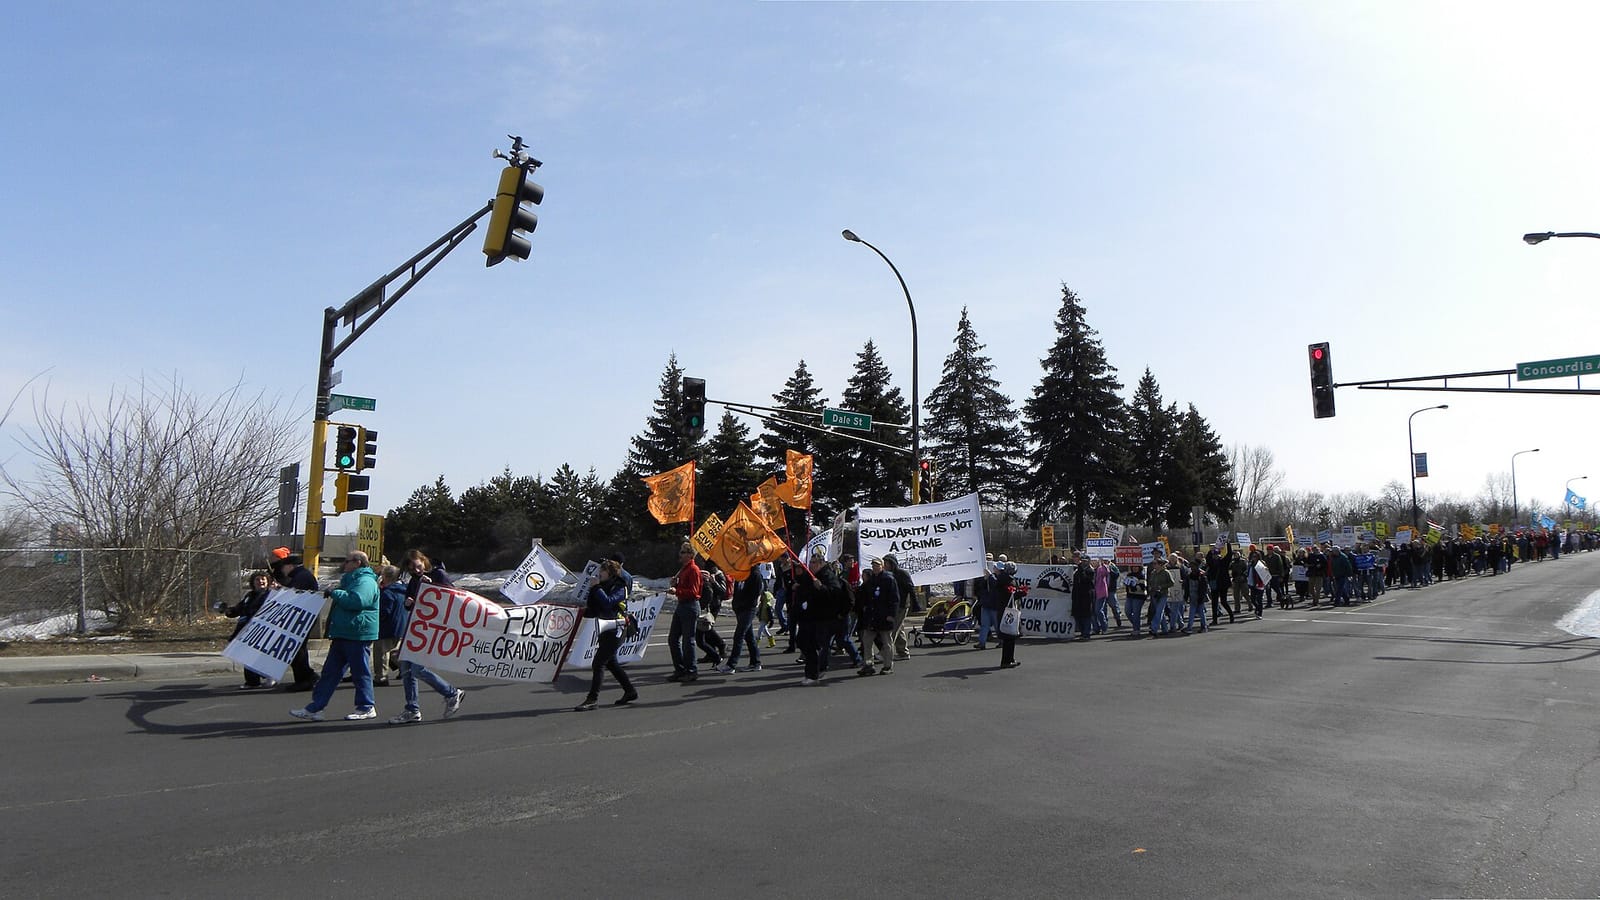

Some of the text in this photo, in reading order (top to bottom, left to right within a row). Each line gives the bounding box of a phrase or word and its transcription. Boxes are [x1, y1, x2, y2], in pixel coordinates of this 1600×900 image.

[1523, 361, 1593, 376] Concordia
[832, 414, 863, 426] Dale St
[364, 516, 374, 528] NO
[934, 510, 957, 519] MIDDLE
[711, 516, 723, 531] STO
[860, 525, 929, 539] SOLIDARITY
[933, 523, 947, 534] IS
[950, 518, 973, 532] NOT
[359, 528, 379, 541] BLOOD
[889, 537, 943, 553] A CRIME
[416, 587, 498, 629] STOP
[503, 606, 547, 638] FBI
[1020, 599, 1050, 611] NOMY
[549, 613, 572, 632] SDS
[1020, 619, 1073, 634] FOR YOU?
[242, 623, 302, 664] DOLLAR!
[406, 619, 474, 658] STOP
[492, 636, 537, 661] GRAND
[533, 641, 569, 666] JURY
[619, 644, 633, 656] OUT
